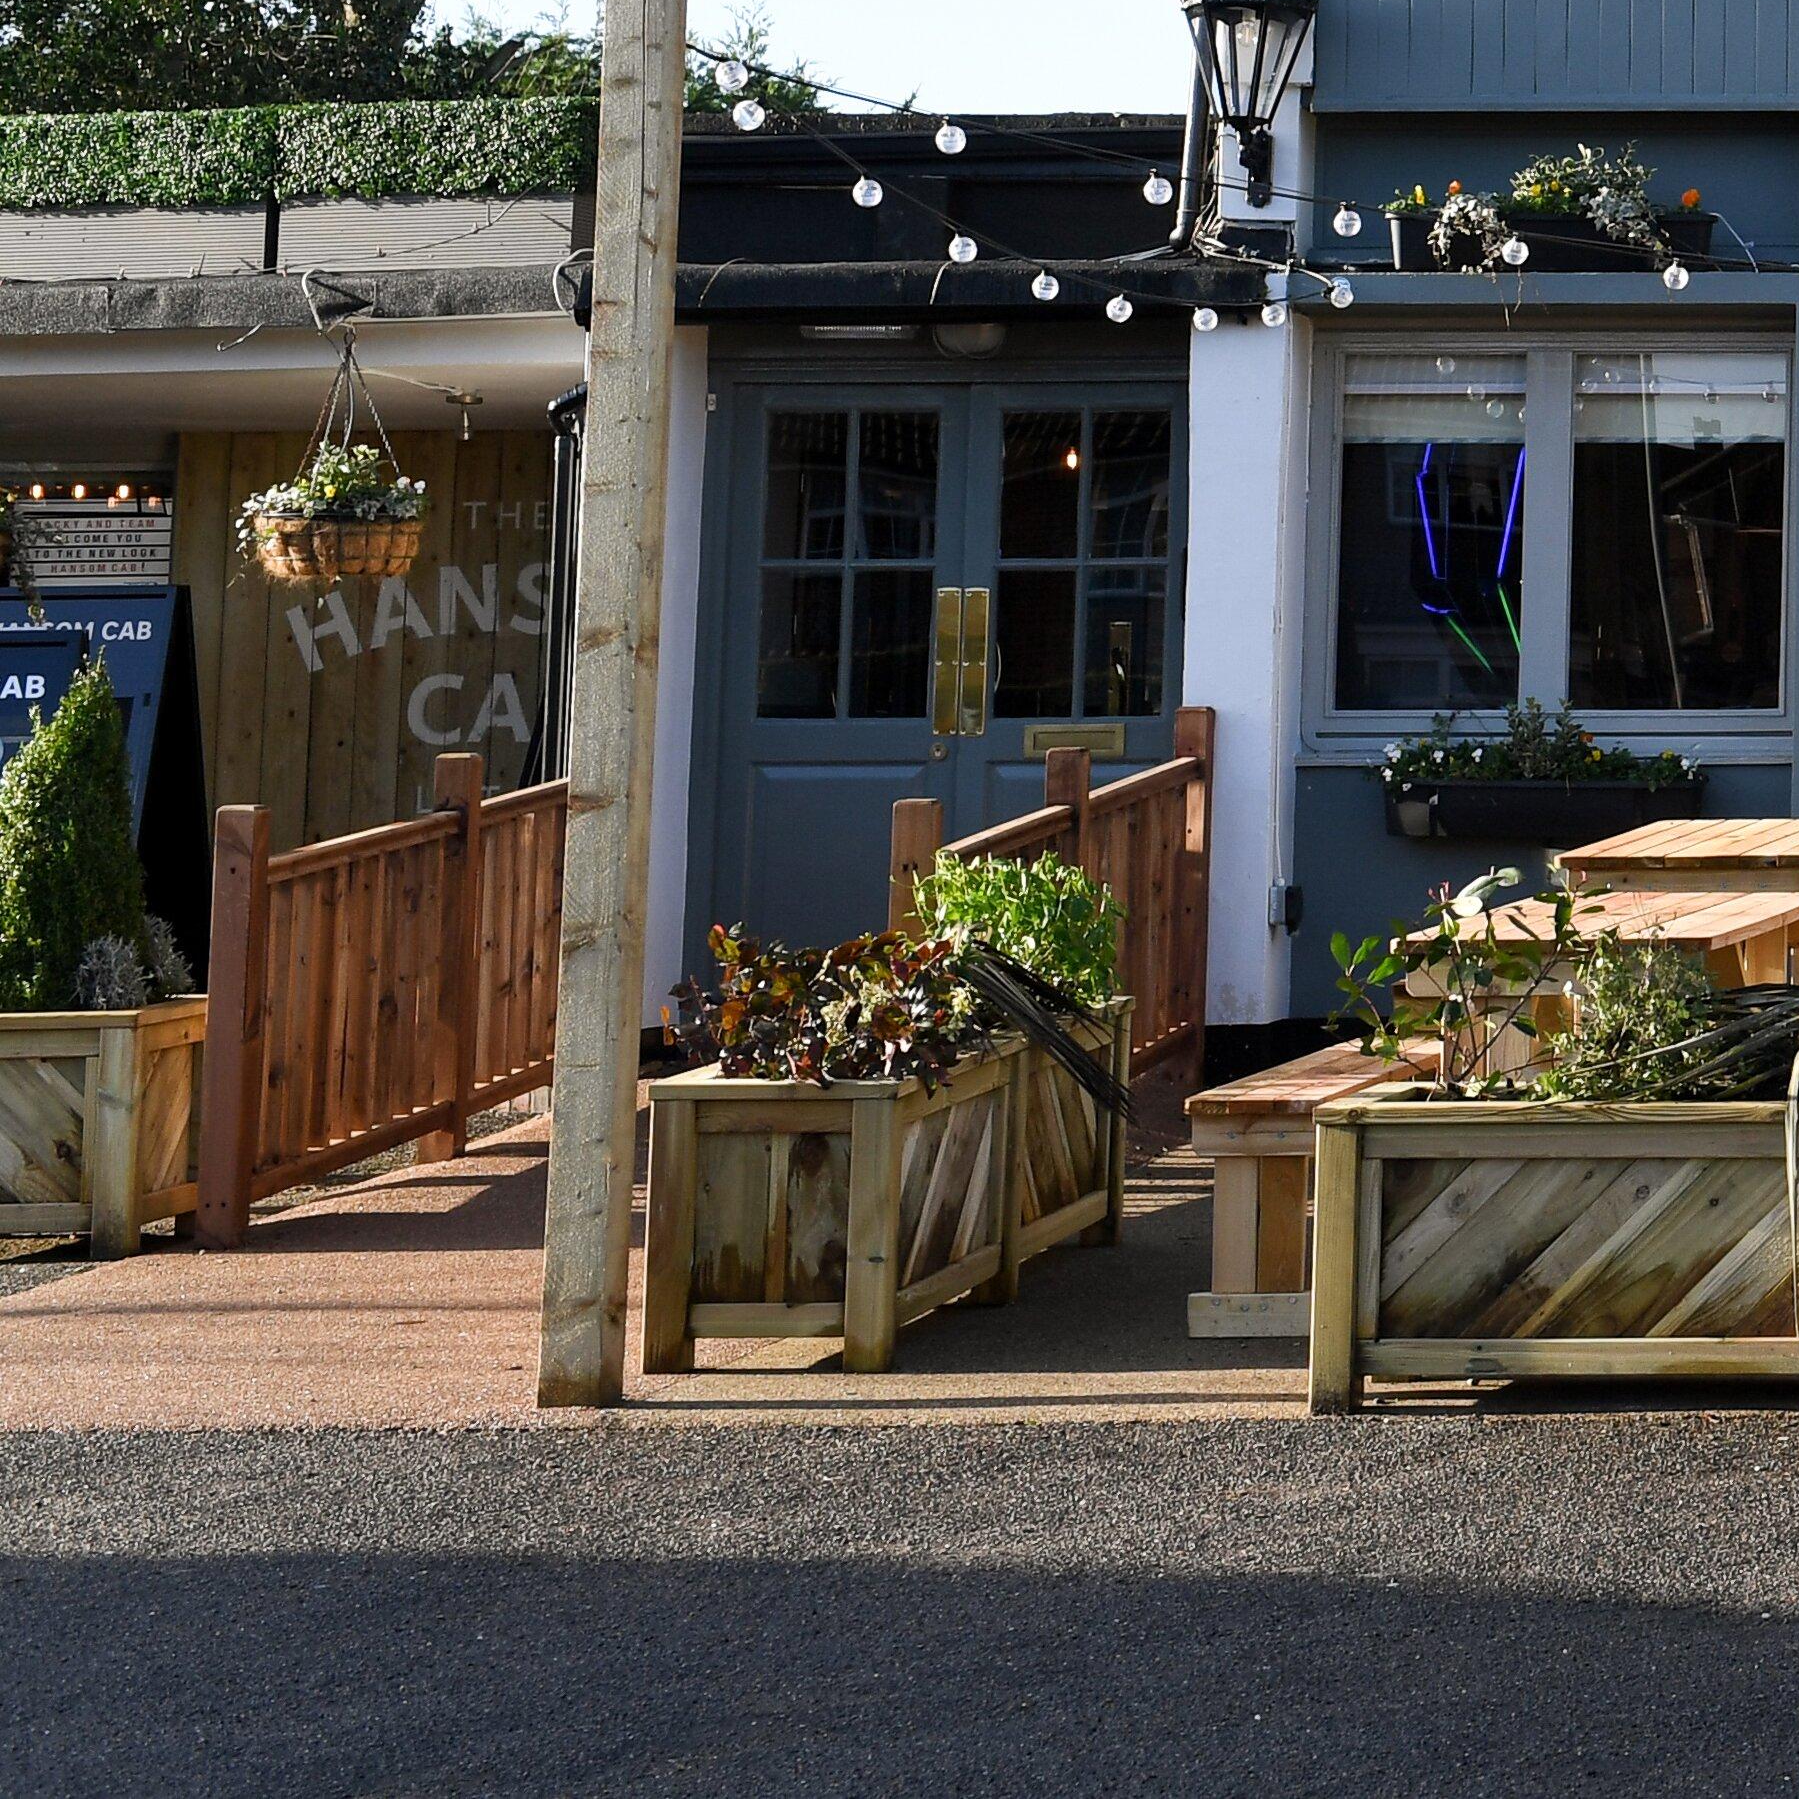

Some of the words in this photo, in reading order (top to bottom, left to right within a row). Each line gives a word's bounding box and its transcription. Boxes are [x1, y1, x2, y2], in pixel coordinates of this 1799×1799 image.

[86, 519, 112, 529] AND
[119, 518, 156, 528] TEAM
[463, 501, 551, 530] THE
[45, 534, 109, 544] WLCOME
[116, 533, 142, 543] YOU
[34, 548, 50, 559] TO
[57, 548, 82, 559] THE
[88, 548, 116, 559] NEW
[121, 547, 157, 558] LOOK
[50, 563, 107, 574] HANSOM
[111, 562, 146, 573] CAB!
[285, 562, 552, 673] HANS
[101, 620, 152, 641] CAB
[0, 674, 46, 700] AB
[407, 672, 532, 746] CA
